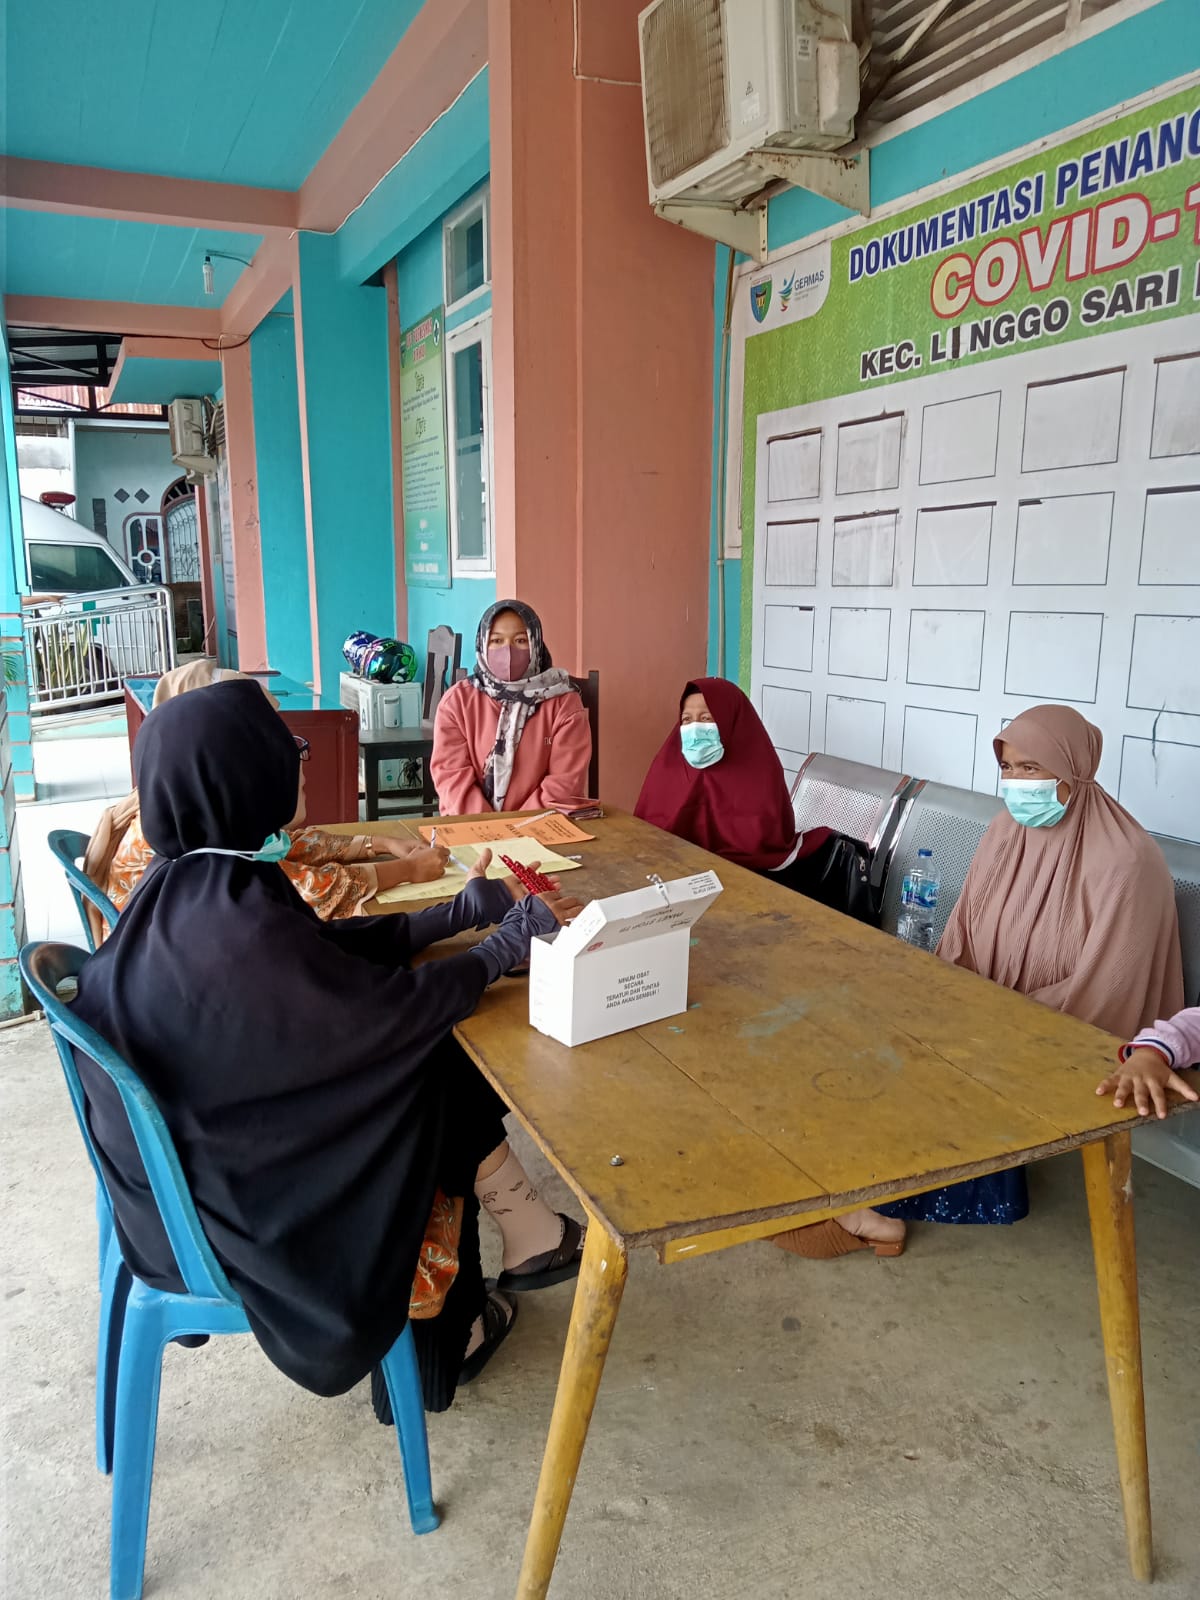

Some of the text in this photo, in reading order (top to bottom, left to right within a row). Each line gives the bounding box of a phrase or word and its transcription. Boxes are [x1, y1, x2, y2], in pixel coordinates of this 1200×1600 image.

[849, 174, 1044, 281] DOKUMENTASI
[794, 270, 825, 291] GERMAS
[861, 342, 921, 379] KEC.
[931, 300, 1069, 360] LINGGO
[1081, 269, 1179, 323] SARI
[606, 981, 660, 1002] TERATUR DAN TUNTAS
[623, 979, 644, 990] SECARA
[606, 1000, 621, 1009] ANDA
[621, 996, 635, 1004] AKAN
[635, 989, 657, 1000] SEMBUH
